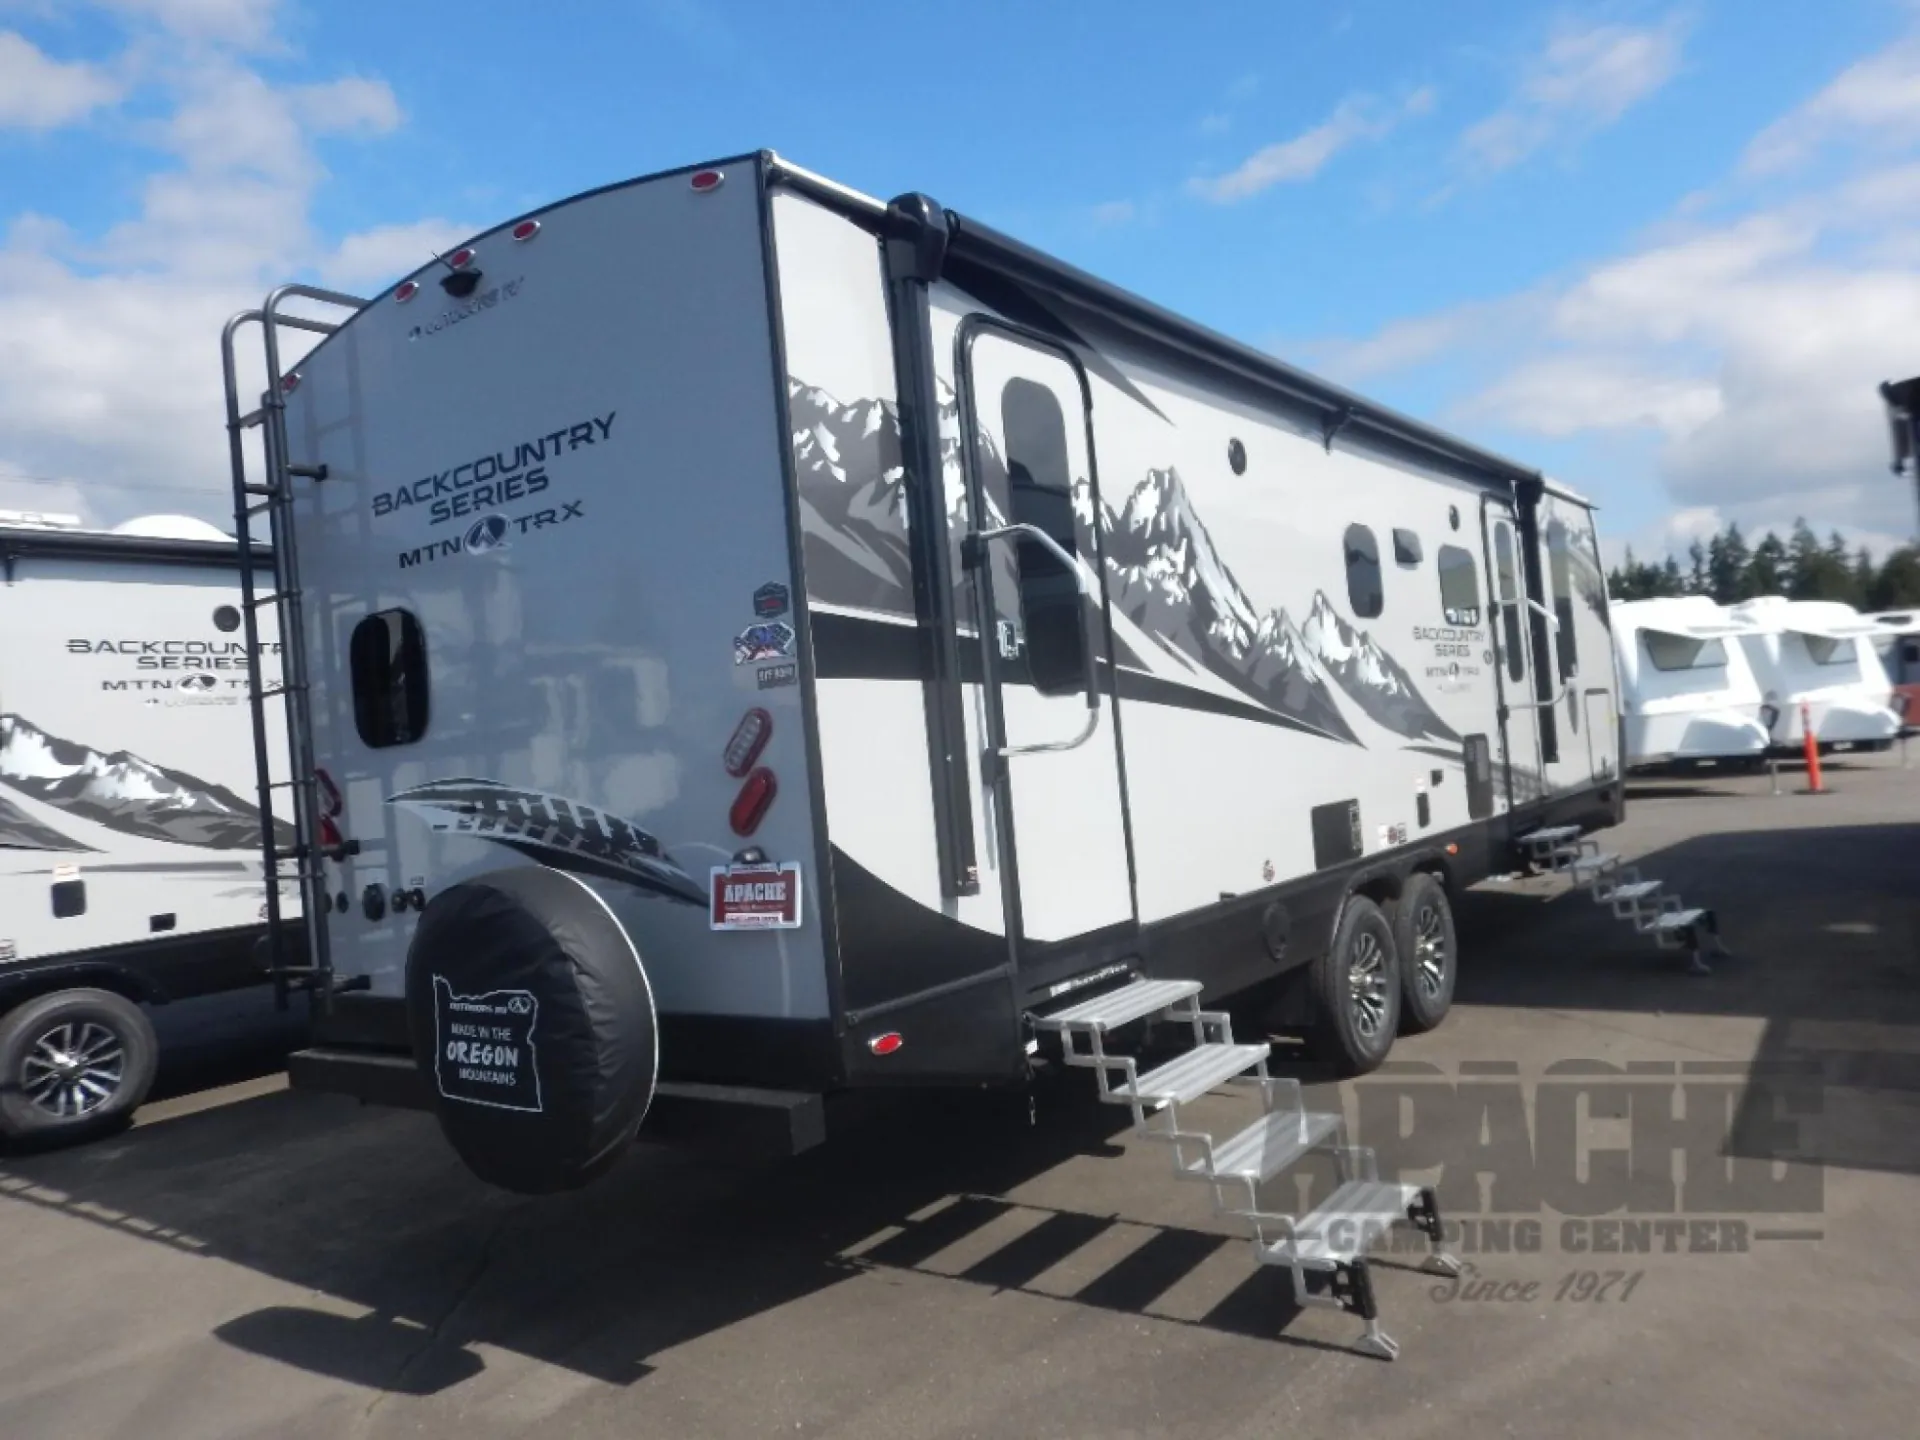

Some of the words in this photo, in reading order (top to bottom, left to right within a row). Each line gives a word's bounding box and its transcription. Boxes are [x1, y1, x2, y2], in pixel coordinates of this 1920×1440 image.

[371, 411, 616, 517] BACKCOUNTRY
[430, 467, 549, 525] SERIES
[399, 536, 463, 568] MTN
[513, 500, 584, 534] TRX
[66, 639, 283, 655] BACKCOUNT
[137, 656, 250, 669] SERIES
[102, 680, 172, 690] MTN
[225, 680, 284, 690] TX
[724, 882, 786, 903] APACHE
[451, 1023, 477, 1037] MADE
[491, 1027, 512, 1041] THE
[446, 1040, 519, 1067] OREGON
[458, 1067, 517, 1086] MOUNTAINS
